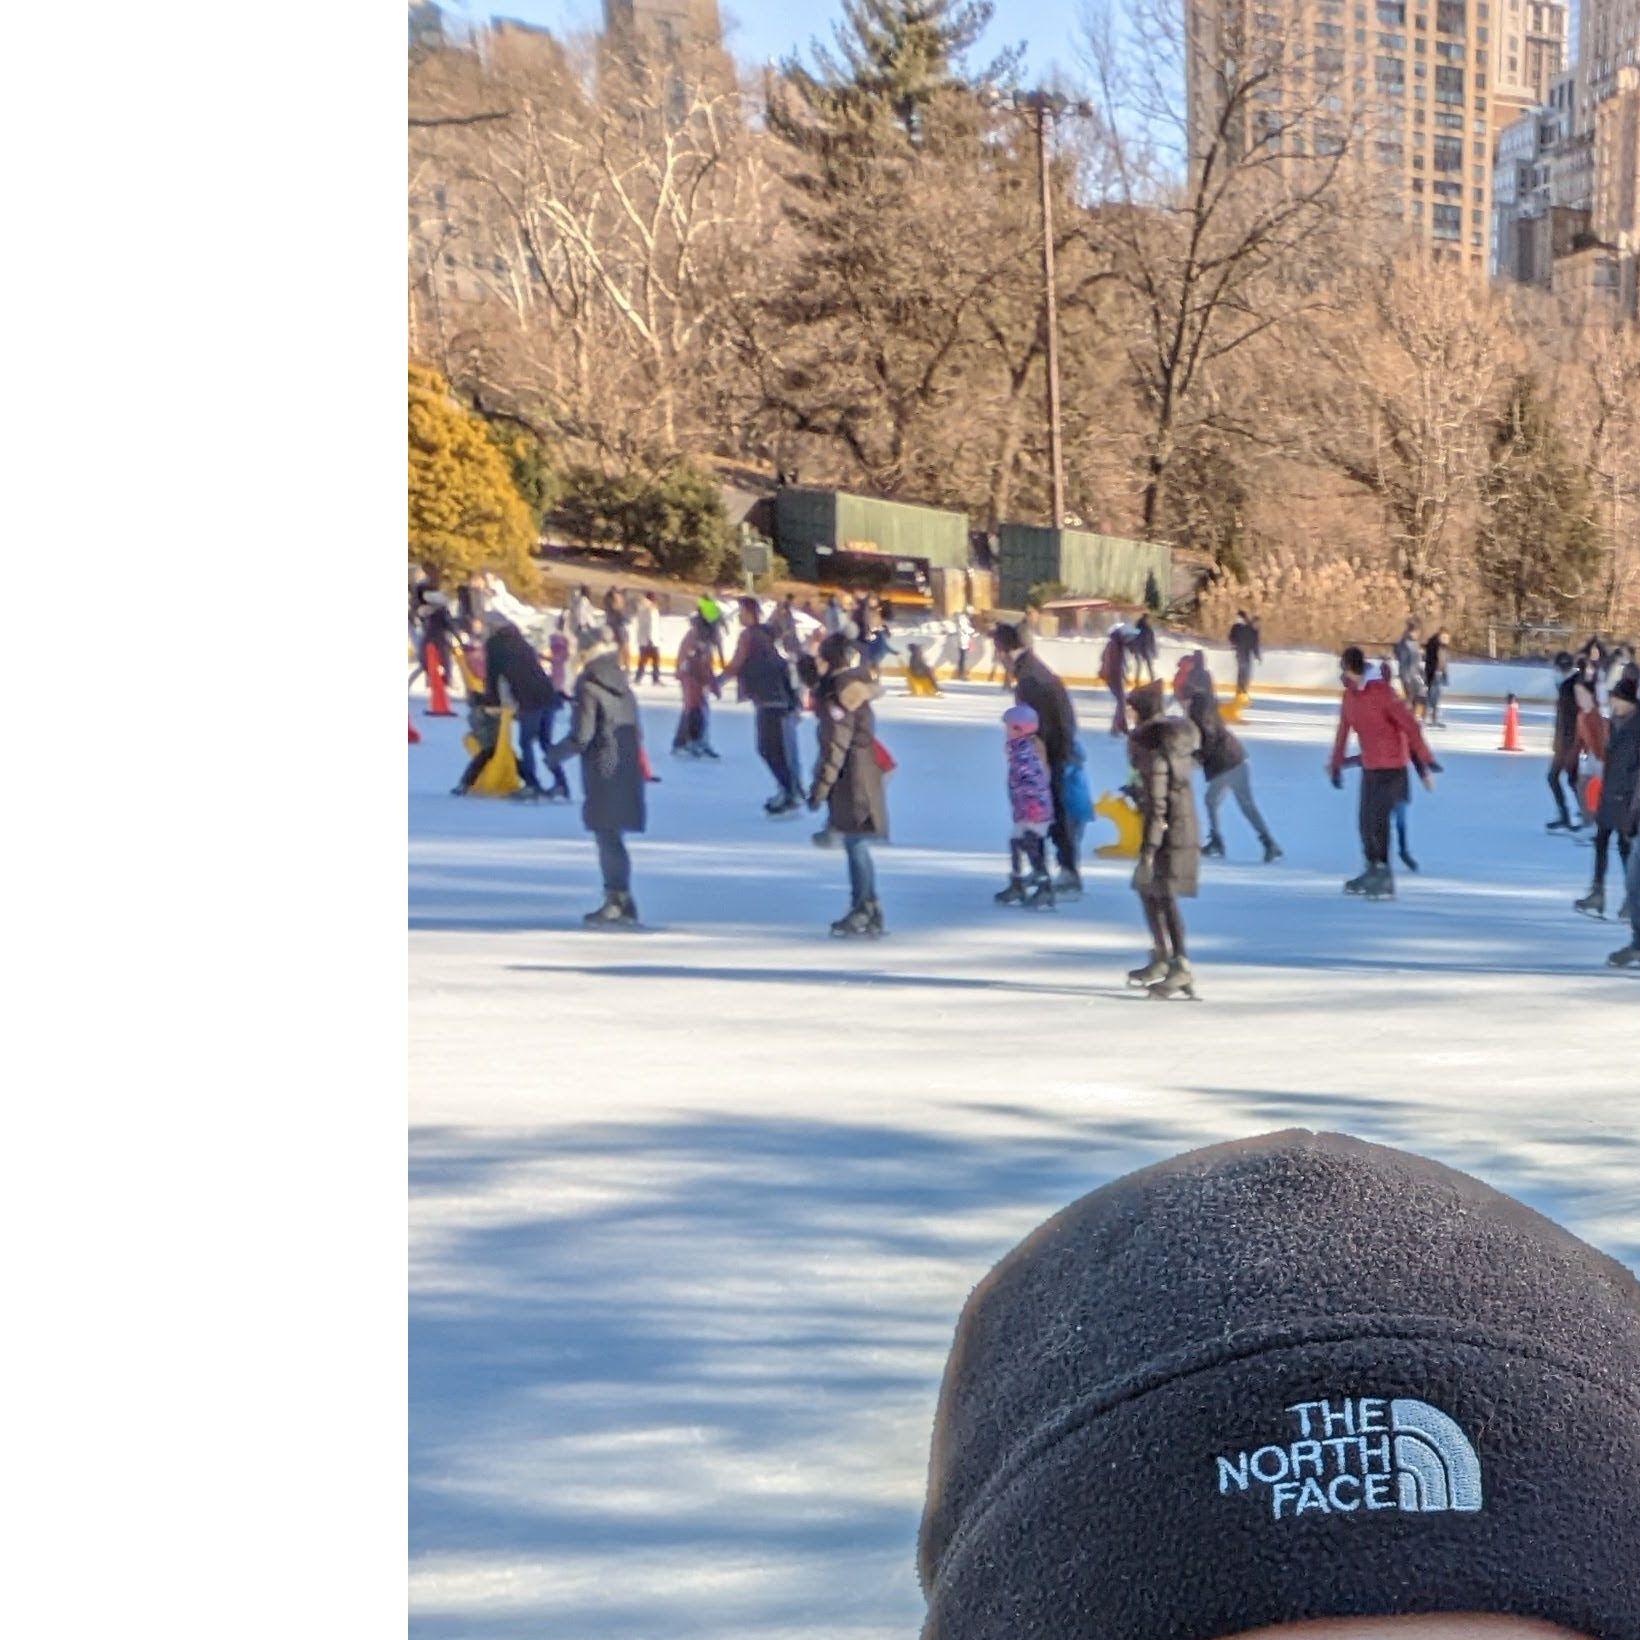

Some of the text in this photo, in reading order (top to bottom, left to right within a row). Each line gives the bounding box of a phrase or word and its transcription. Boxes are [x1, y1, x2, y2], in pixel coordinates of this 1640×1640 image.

[1284, 1397, 1389, 1437] THE
[1216, 1434, 1392, 1494] NORTH
[1271, 1473, 1397, 1520] FACE
